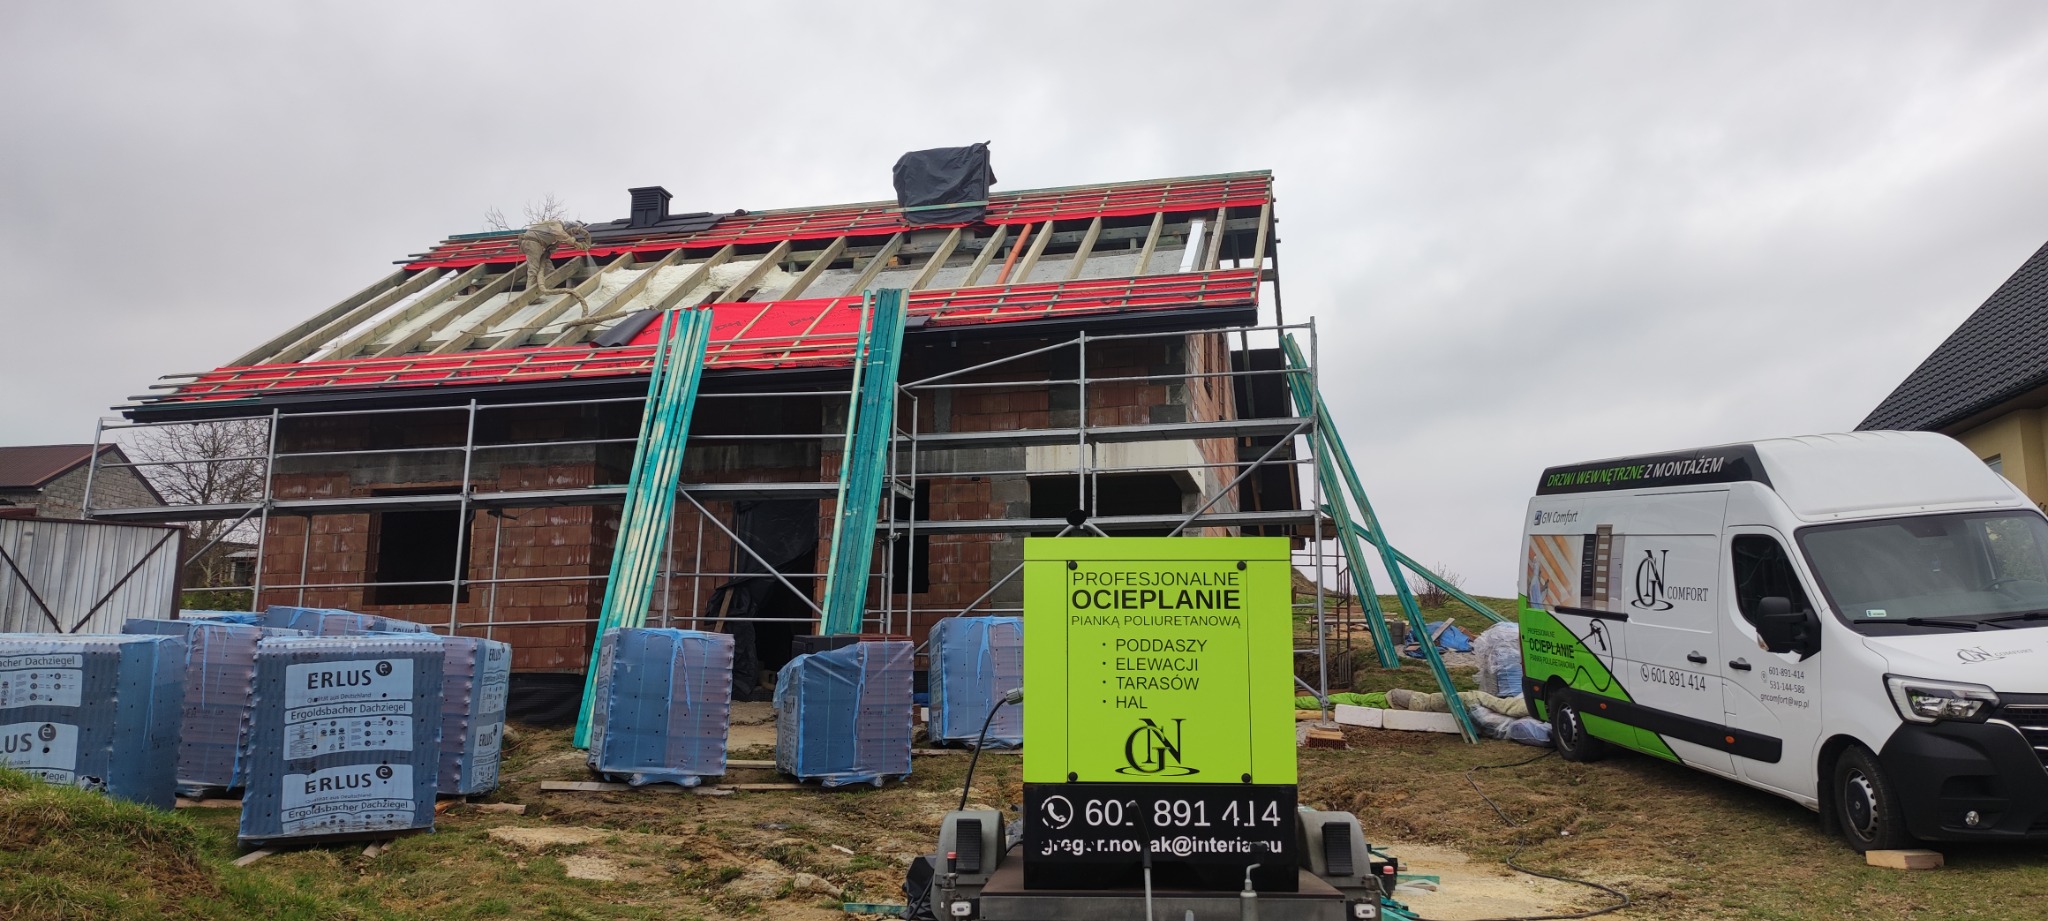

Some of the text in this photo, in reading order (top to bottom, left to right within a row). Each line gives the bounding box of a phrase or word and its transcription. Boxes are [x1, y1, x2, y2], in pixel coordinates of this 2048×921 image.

[1547, 456, 1724, 487] DRZWI WEWNĘTRZNE Z MONTAŻEM
[1542, 509, 1578, 525] GN Comfort
[1073, 572, 1240, 586] PROFESJONALNE
[1072, 589, 1241, 610] OCIEPLANIE
[1667, 586, 1708, 602] COMFORT
[1071, 615, 1241, 628] PIANKĄ POLIURETANOWĄ
[1116, 638, 1207, 652] PODDASZY
[1529, 637, 1575, 659] OCIEPLANIE
[25, 656, 75, 666] Dachziegel
[1116, 657, 1198, 671] ELEWACJI
[307, 670, 372, 690] ERLUS
[1651, 667, 1706, 691] 601 891 414
[1769, 666, 1804, 679] 601-891-414
[1115, 674, 1200, 690] TARASÓW
[1116, 696, 1148, 708] HAL
[290, 703, 406, 721] Ergoldsbacher Dachziegel
[0, 733, 32, 754] US
[305, 773, 372, 795] ERLUS
[288, 801, 408, 819] Ergoldsbacher Dachziegel
[1153, 799, 1211, 826] 891
[1221, 800, 1281, 826] 414
